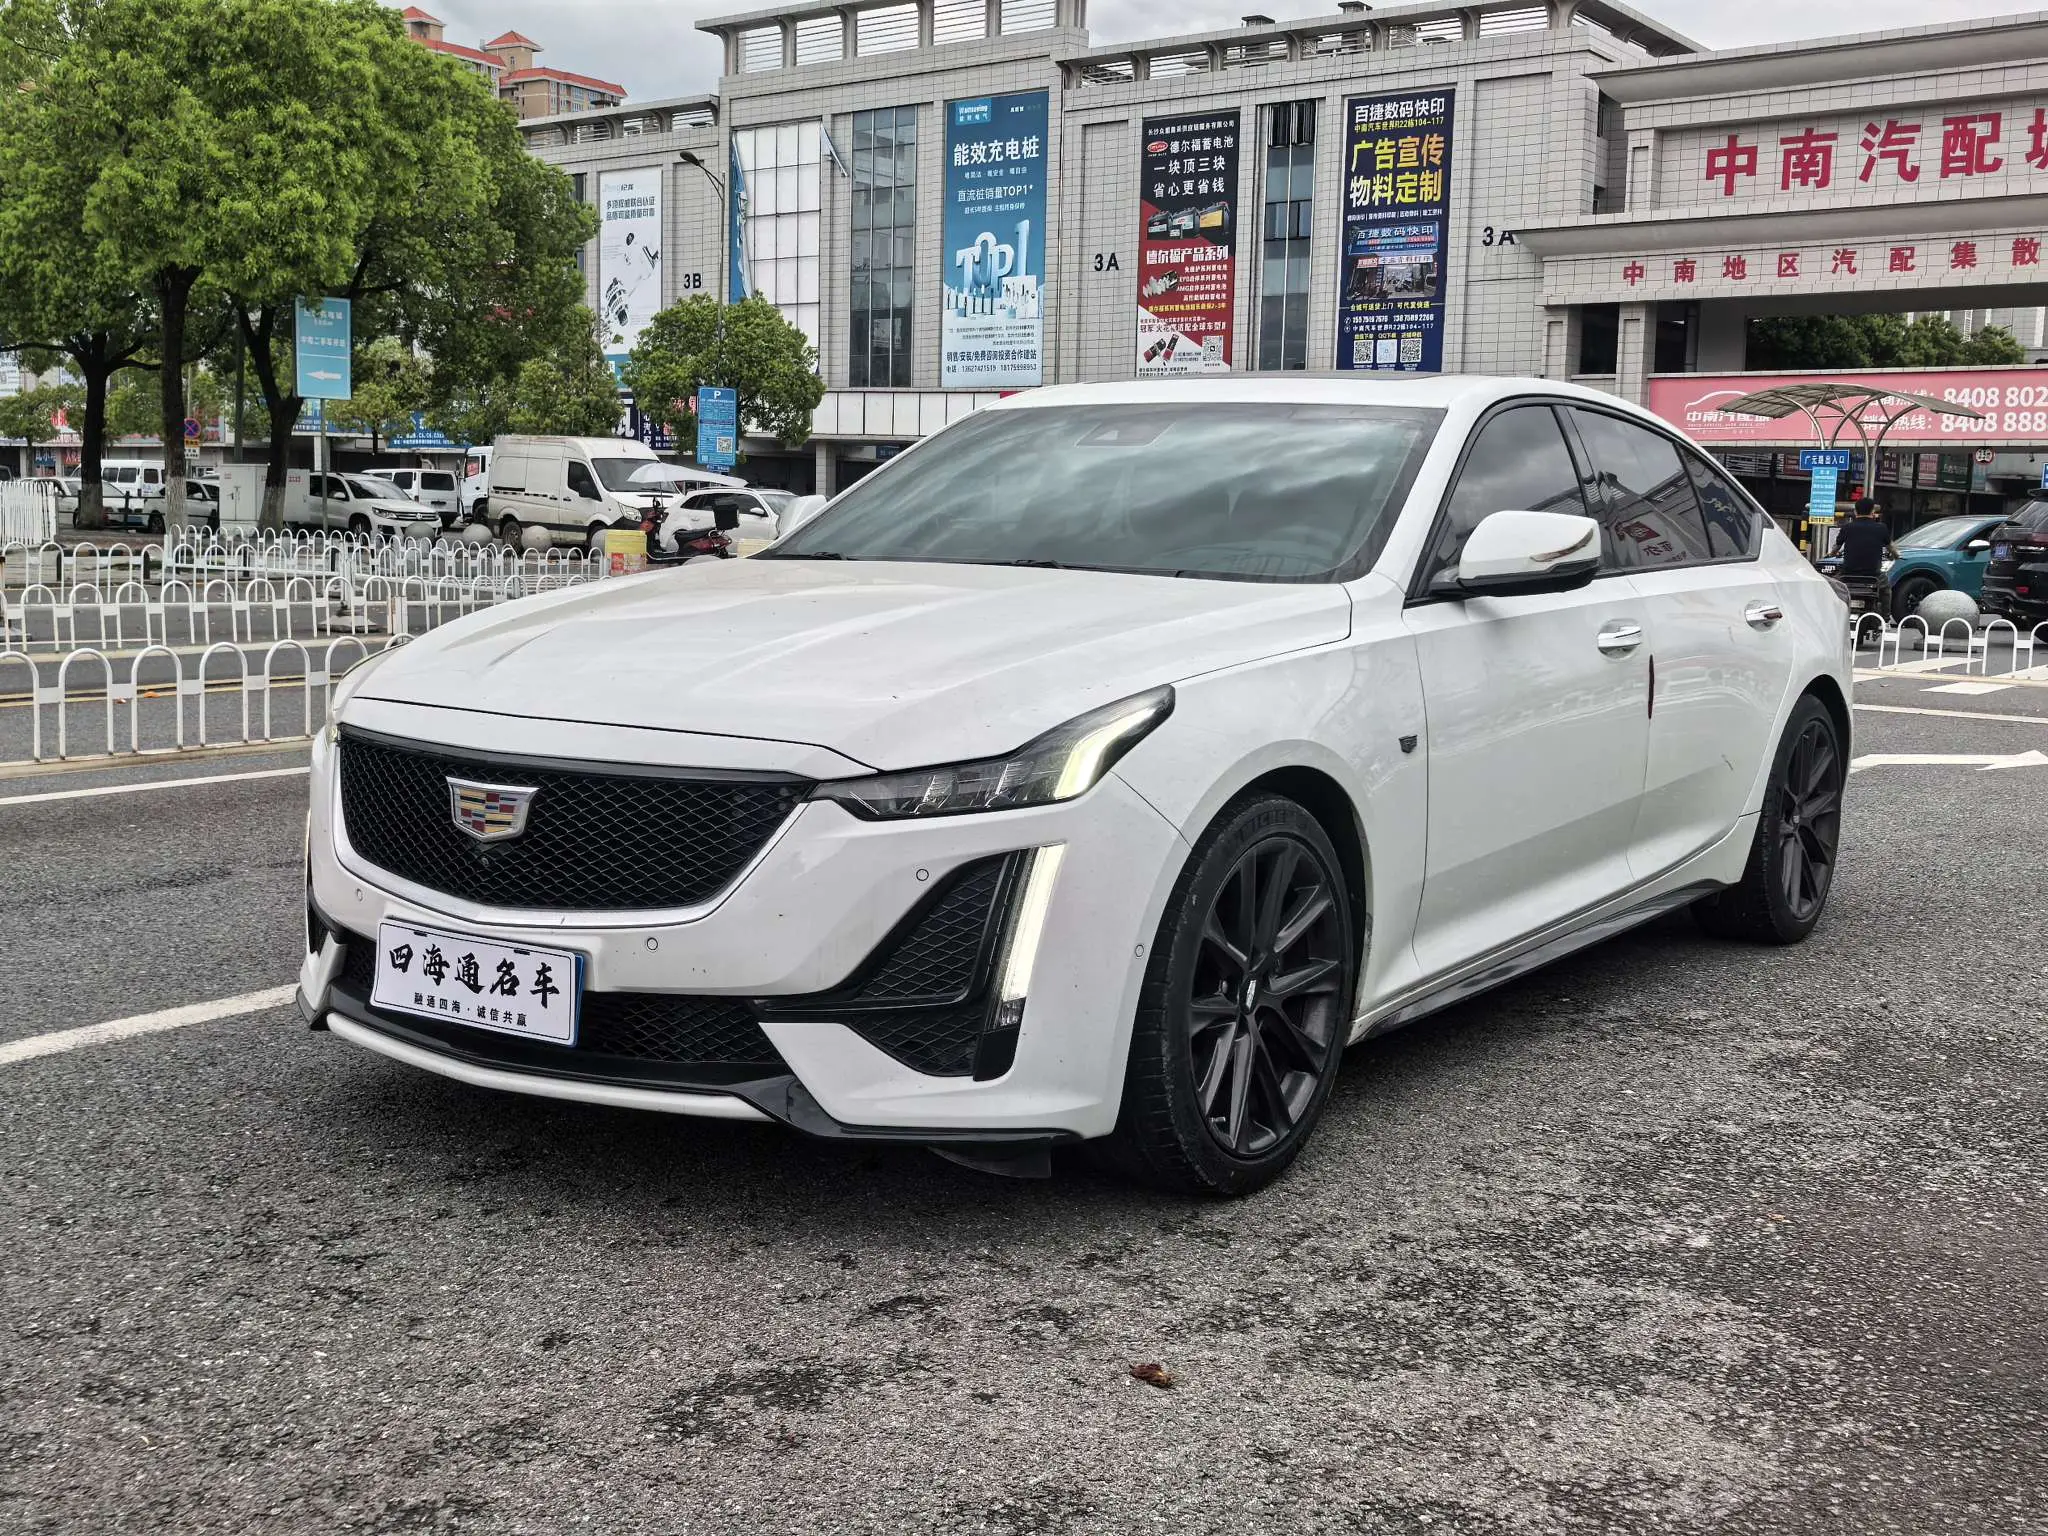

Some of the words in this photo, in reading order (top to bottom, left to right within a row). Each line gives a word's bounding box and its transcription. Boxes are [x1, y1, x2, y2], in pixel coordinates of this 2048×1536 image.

[1354, 97, 1445, 123] 百捷数码快印
[953, 135, 1040, 167] 能效充电桩
[1170, 135, 1234, 154] 德尔福蓄电池
[1351, 133, 1445, 172] 广告宣传
[1153, 155, 1226, 175] 一块顶三块
[1153, 177, 1225, 198] 省心更省钱
[1349, 169, 1443, 208] 物料定制
[1482, 226, 1516, 247] 3A
[1094, 252, 1119, 271] 3A
[1146, 245, 1229, 265] 德尔福产品系列
[1622, 237, 2040, 286] 中南地区汽配集散
[683, 273, 702, 290] 3B
[1940, 411, 1998, 432] 8408
[1804, 455, 1845, 465] 广元路出入口
[389, 943, 560, 1009] 四海通名车
[413, 991, 528, 1027] 融通四海·诚信共赢
